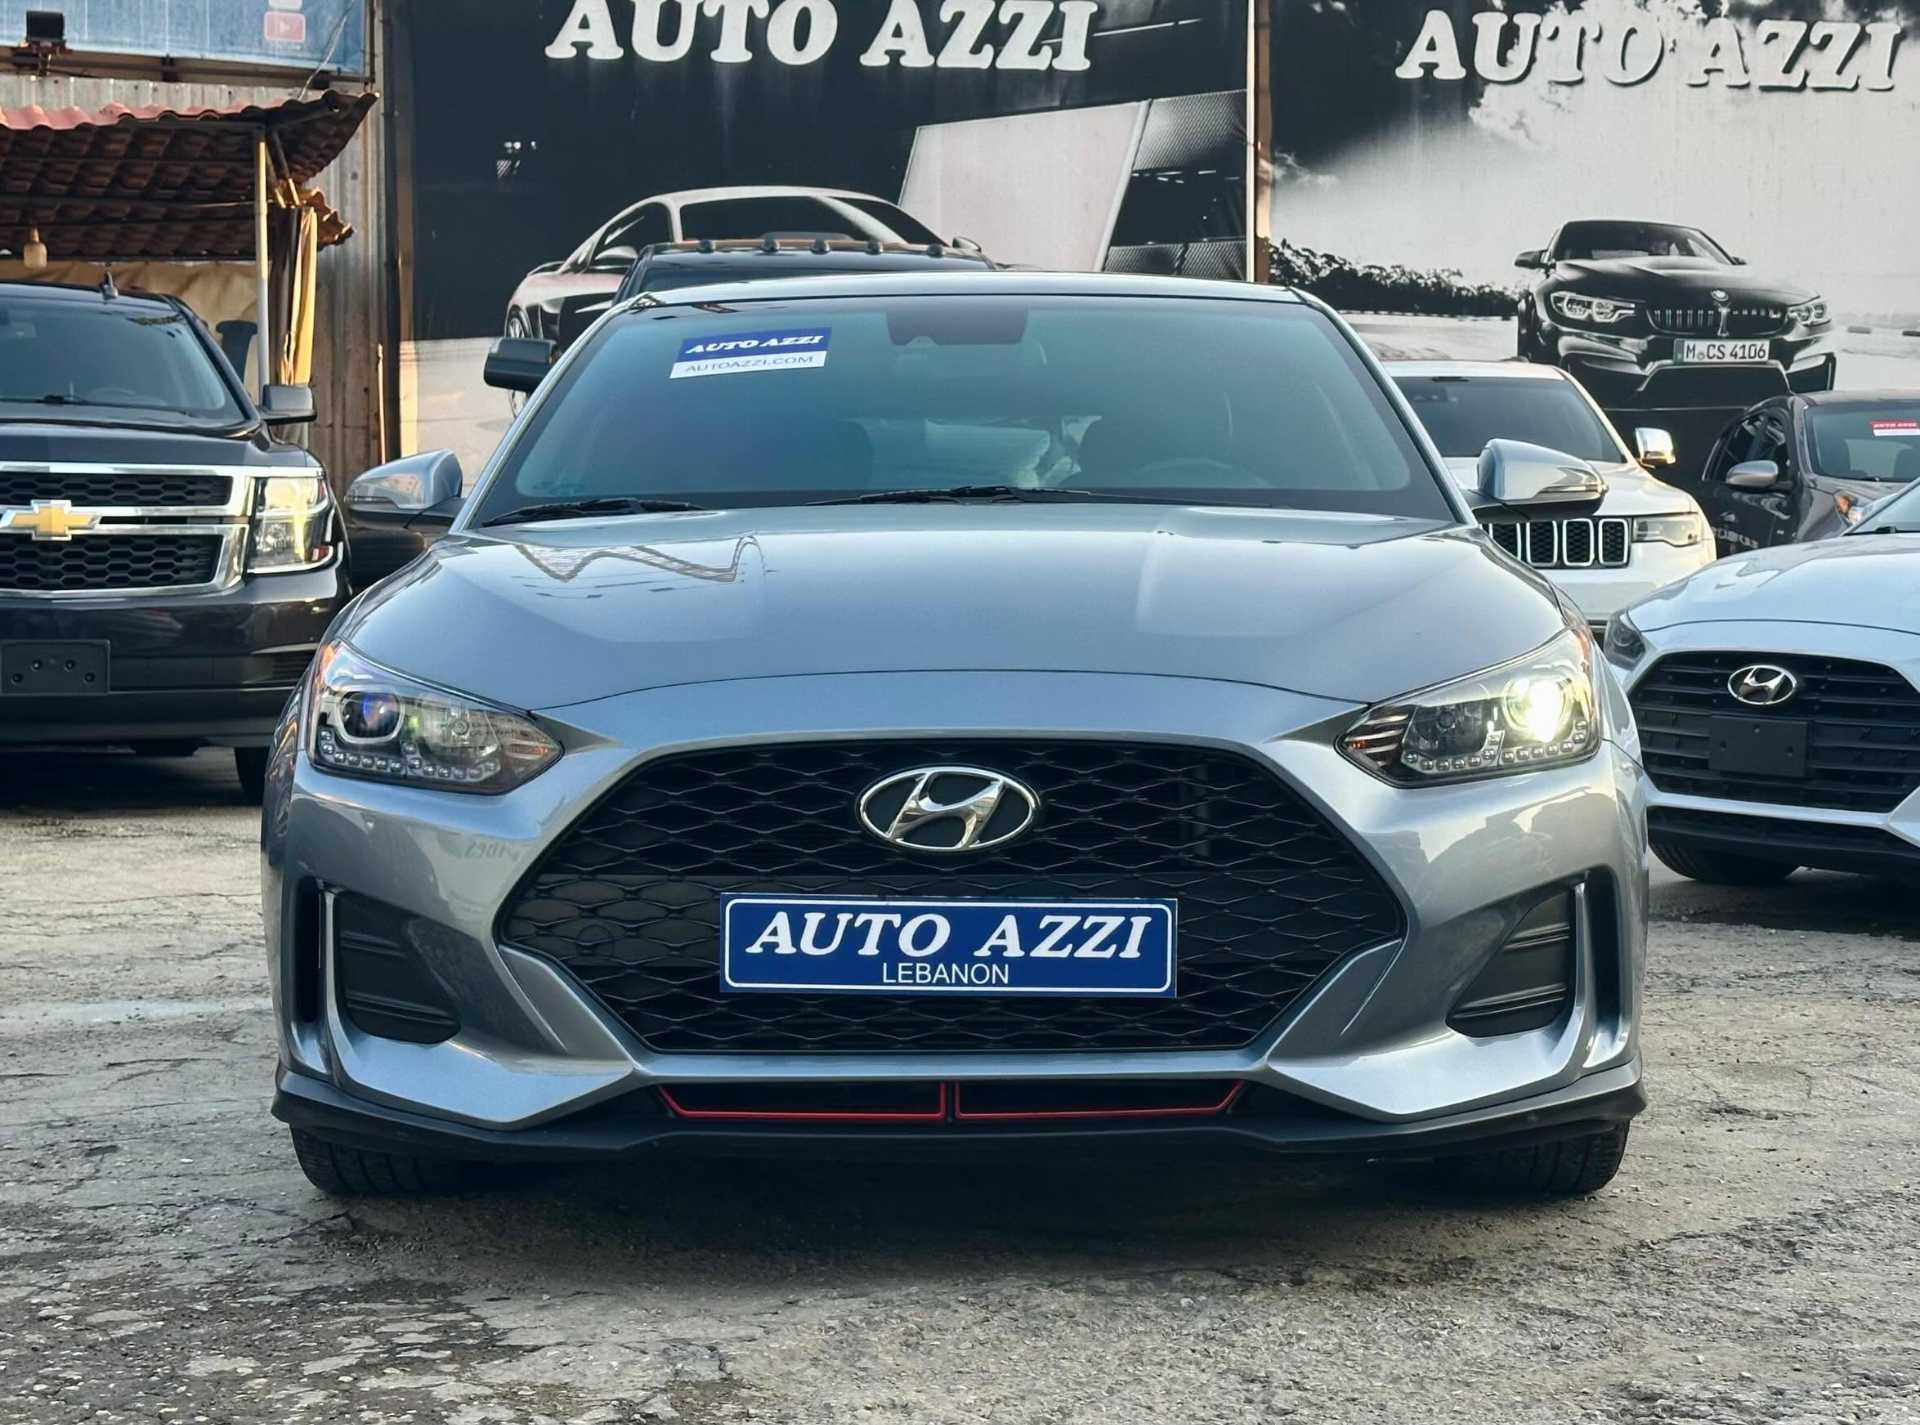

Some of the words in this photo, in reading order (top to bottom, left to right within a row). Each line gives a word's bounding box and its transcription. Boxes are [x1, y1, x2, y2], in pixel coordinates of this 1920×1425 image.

[545, 0, 838, 65] AUTO
[859, 0, 1100, 71] AZZI
[1394, 10, 1665, 87] AUTO
[1686, 18, 1903, 91] AZZI
[685, 339, 759, 354] AUTO
[759, 335, 824, 347] AZZI
[1686, 343, 1696, 360] M
[1706, 344, 1726, 360] CS
[1729, 343, 1767, 360] 4106
[685, 356, 813, 373] AUTOAZZI.COM
[745, 911, 951, 958] AUTO
[974, 914, 1152, 959] AZZI
[882, 962, 1009, 985] LEBANON
